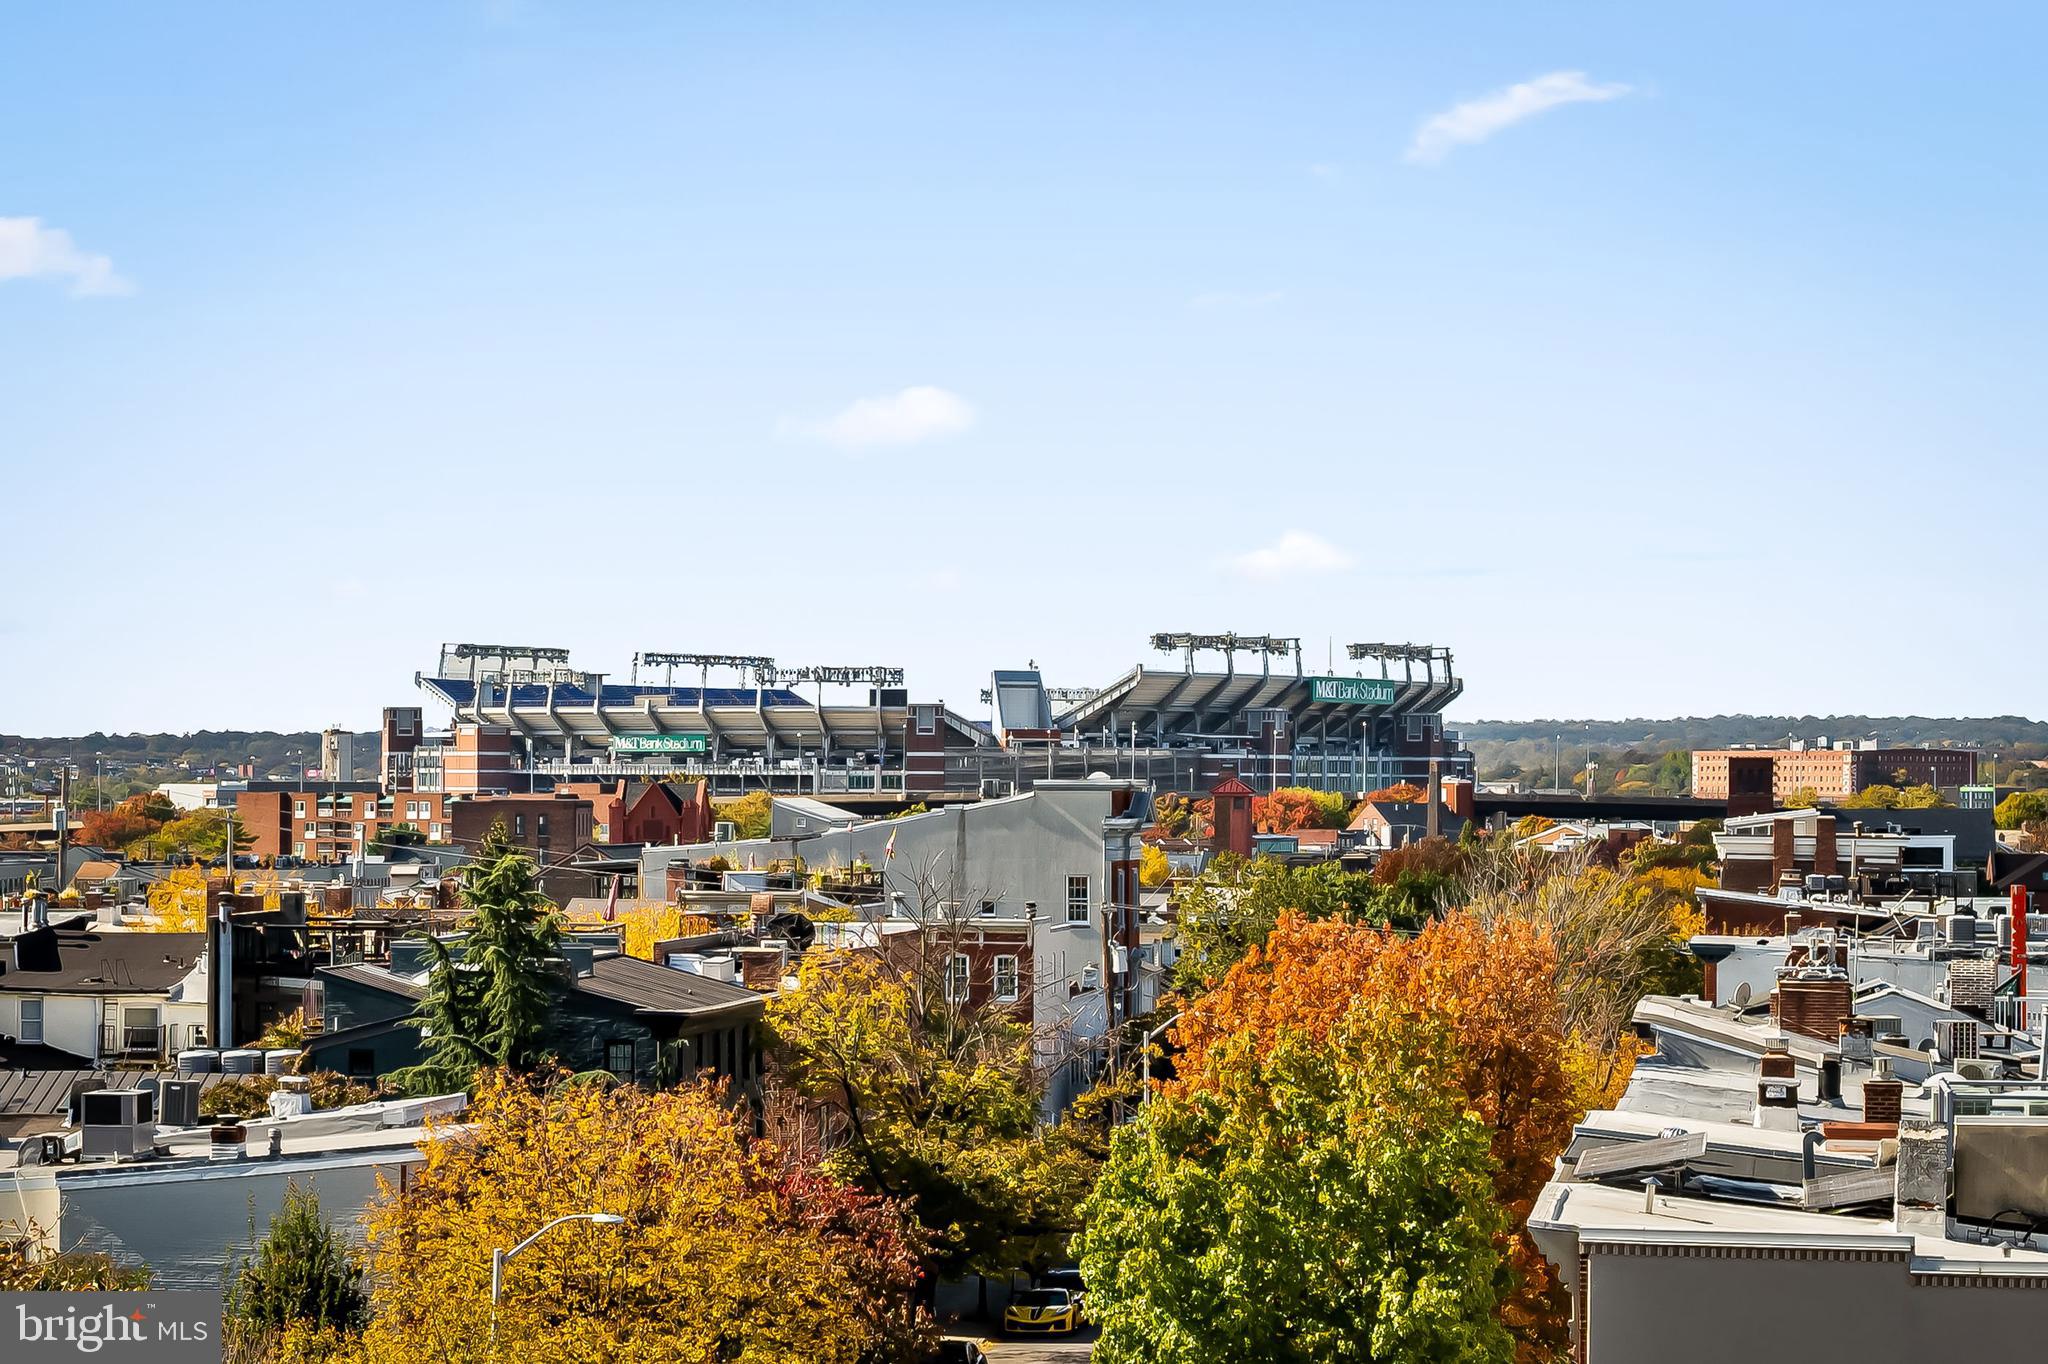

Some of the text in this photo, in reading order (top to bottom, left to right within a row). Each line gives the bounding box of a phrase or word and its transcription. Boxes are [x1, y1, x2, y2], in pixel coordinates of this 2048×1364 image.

[1316, 680, 1393, 700] M&T Bank Stadium
[615, 737, 702, 749] M&T Bank Stadium
